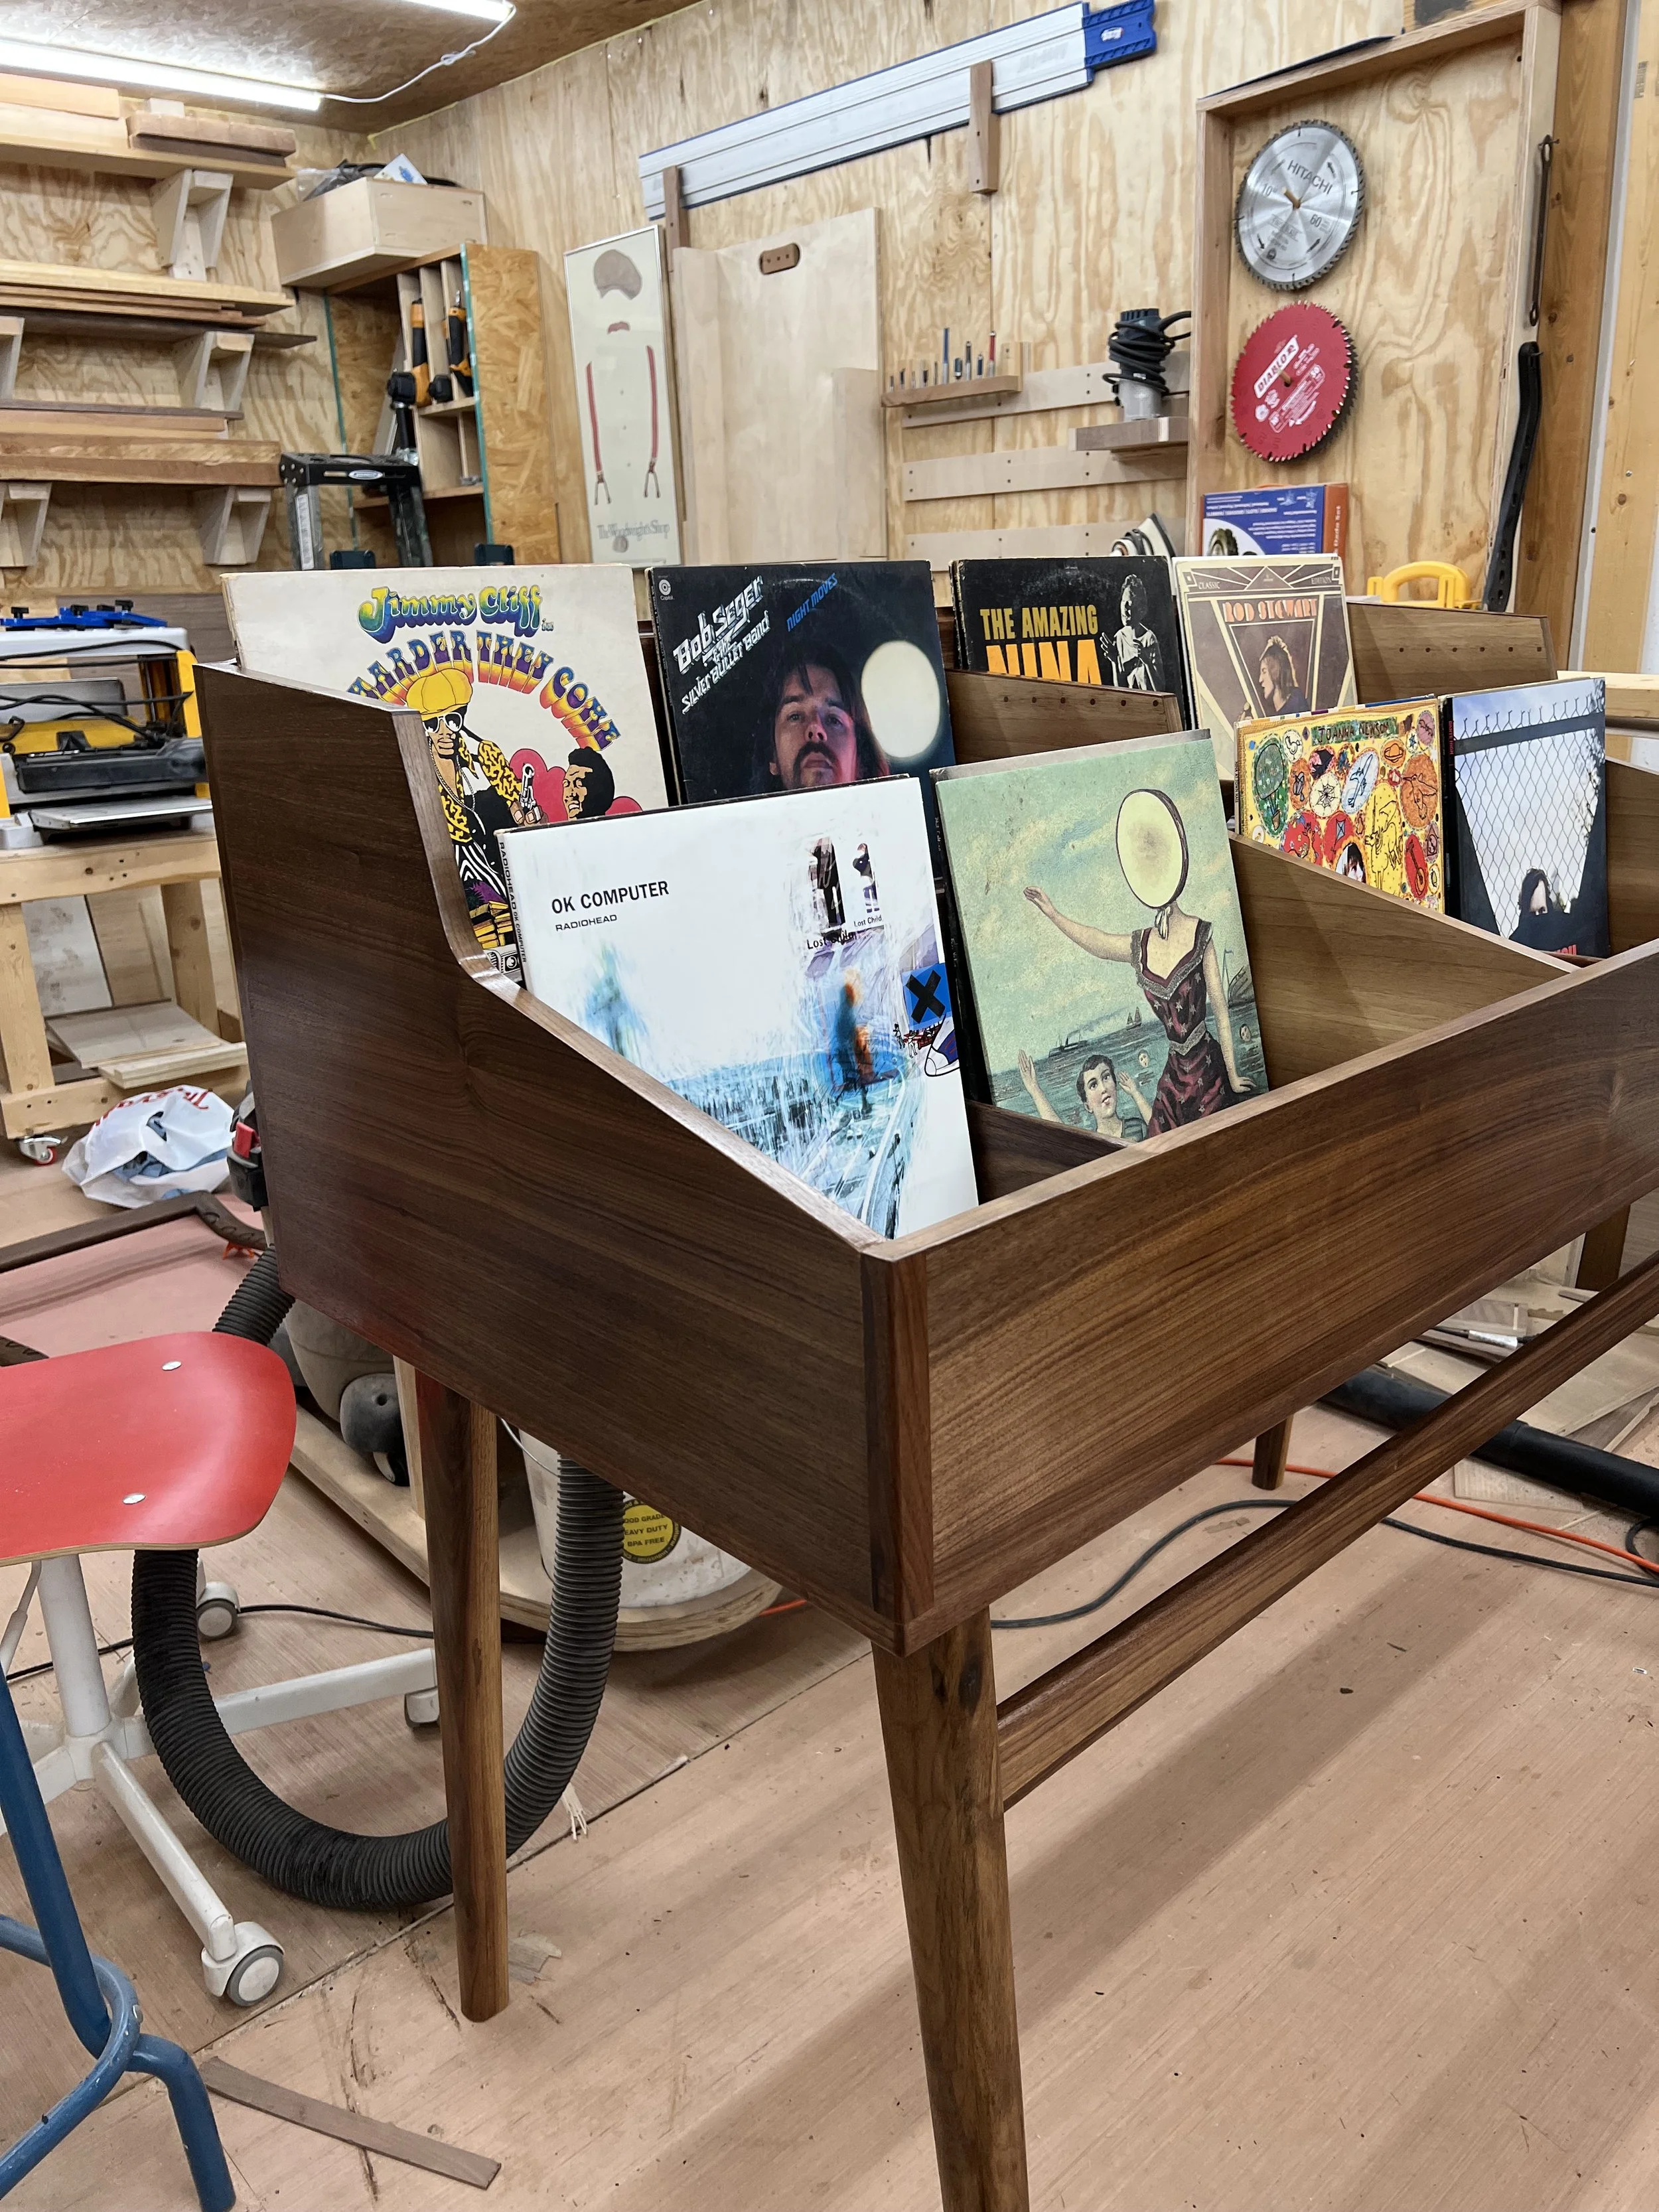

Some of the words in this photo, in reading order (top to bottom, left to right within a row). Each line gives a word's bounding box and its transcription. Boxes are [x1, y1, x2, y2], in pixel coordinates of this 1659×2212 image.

[1287, 160, 1333, 194] HITACHI
[1310, 214, 1322, 228] 60
[1258, 355, 1287, 392] DIABLO
[1198, 581, 1221, 590] CLASSIC
[358, 586, 476, 644] Jimmy
[478, 585, 543, 637] Cliff
[786, 599, 810, 632] NIGHT
[810, 572, 838, 607] MOVES
[1222, 601, 1256, 623] ROD
[1258, 598, 1317, 621] STEWART
[979, 608, 1015, 640] THE
[1022, 604, 1099, 638] AMAZING
[673, 610, 716, 674] Bob
[476, 630, 554, 694] THEY
[540, 666, 621, 751] COME
[1318, 724, 1354, 743] JOANNA
[500, 842, 518, 911] RADIOHEAD
[551, 896, 576, 914] OK
[581, 881, 670, 909] COMPUTER
[514, 911, 520, 922] OK
[555, 915, 618, 932] RADIOHEAD
[853, 919, 867, 928] Lost
[867, 915, 883, 924] Child
[516, 922, 527, 962] COMPUTER
[806, 936, 828, 950] Lost
[645, 1536, 665, 1545] FREE
[646, 1524, 668, 1533] DUTY
